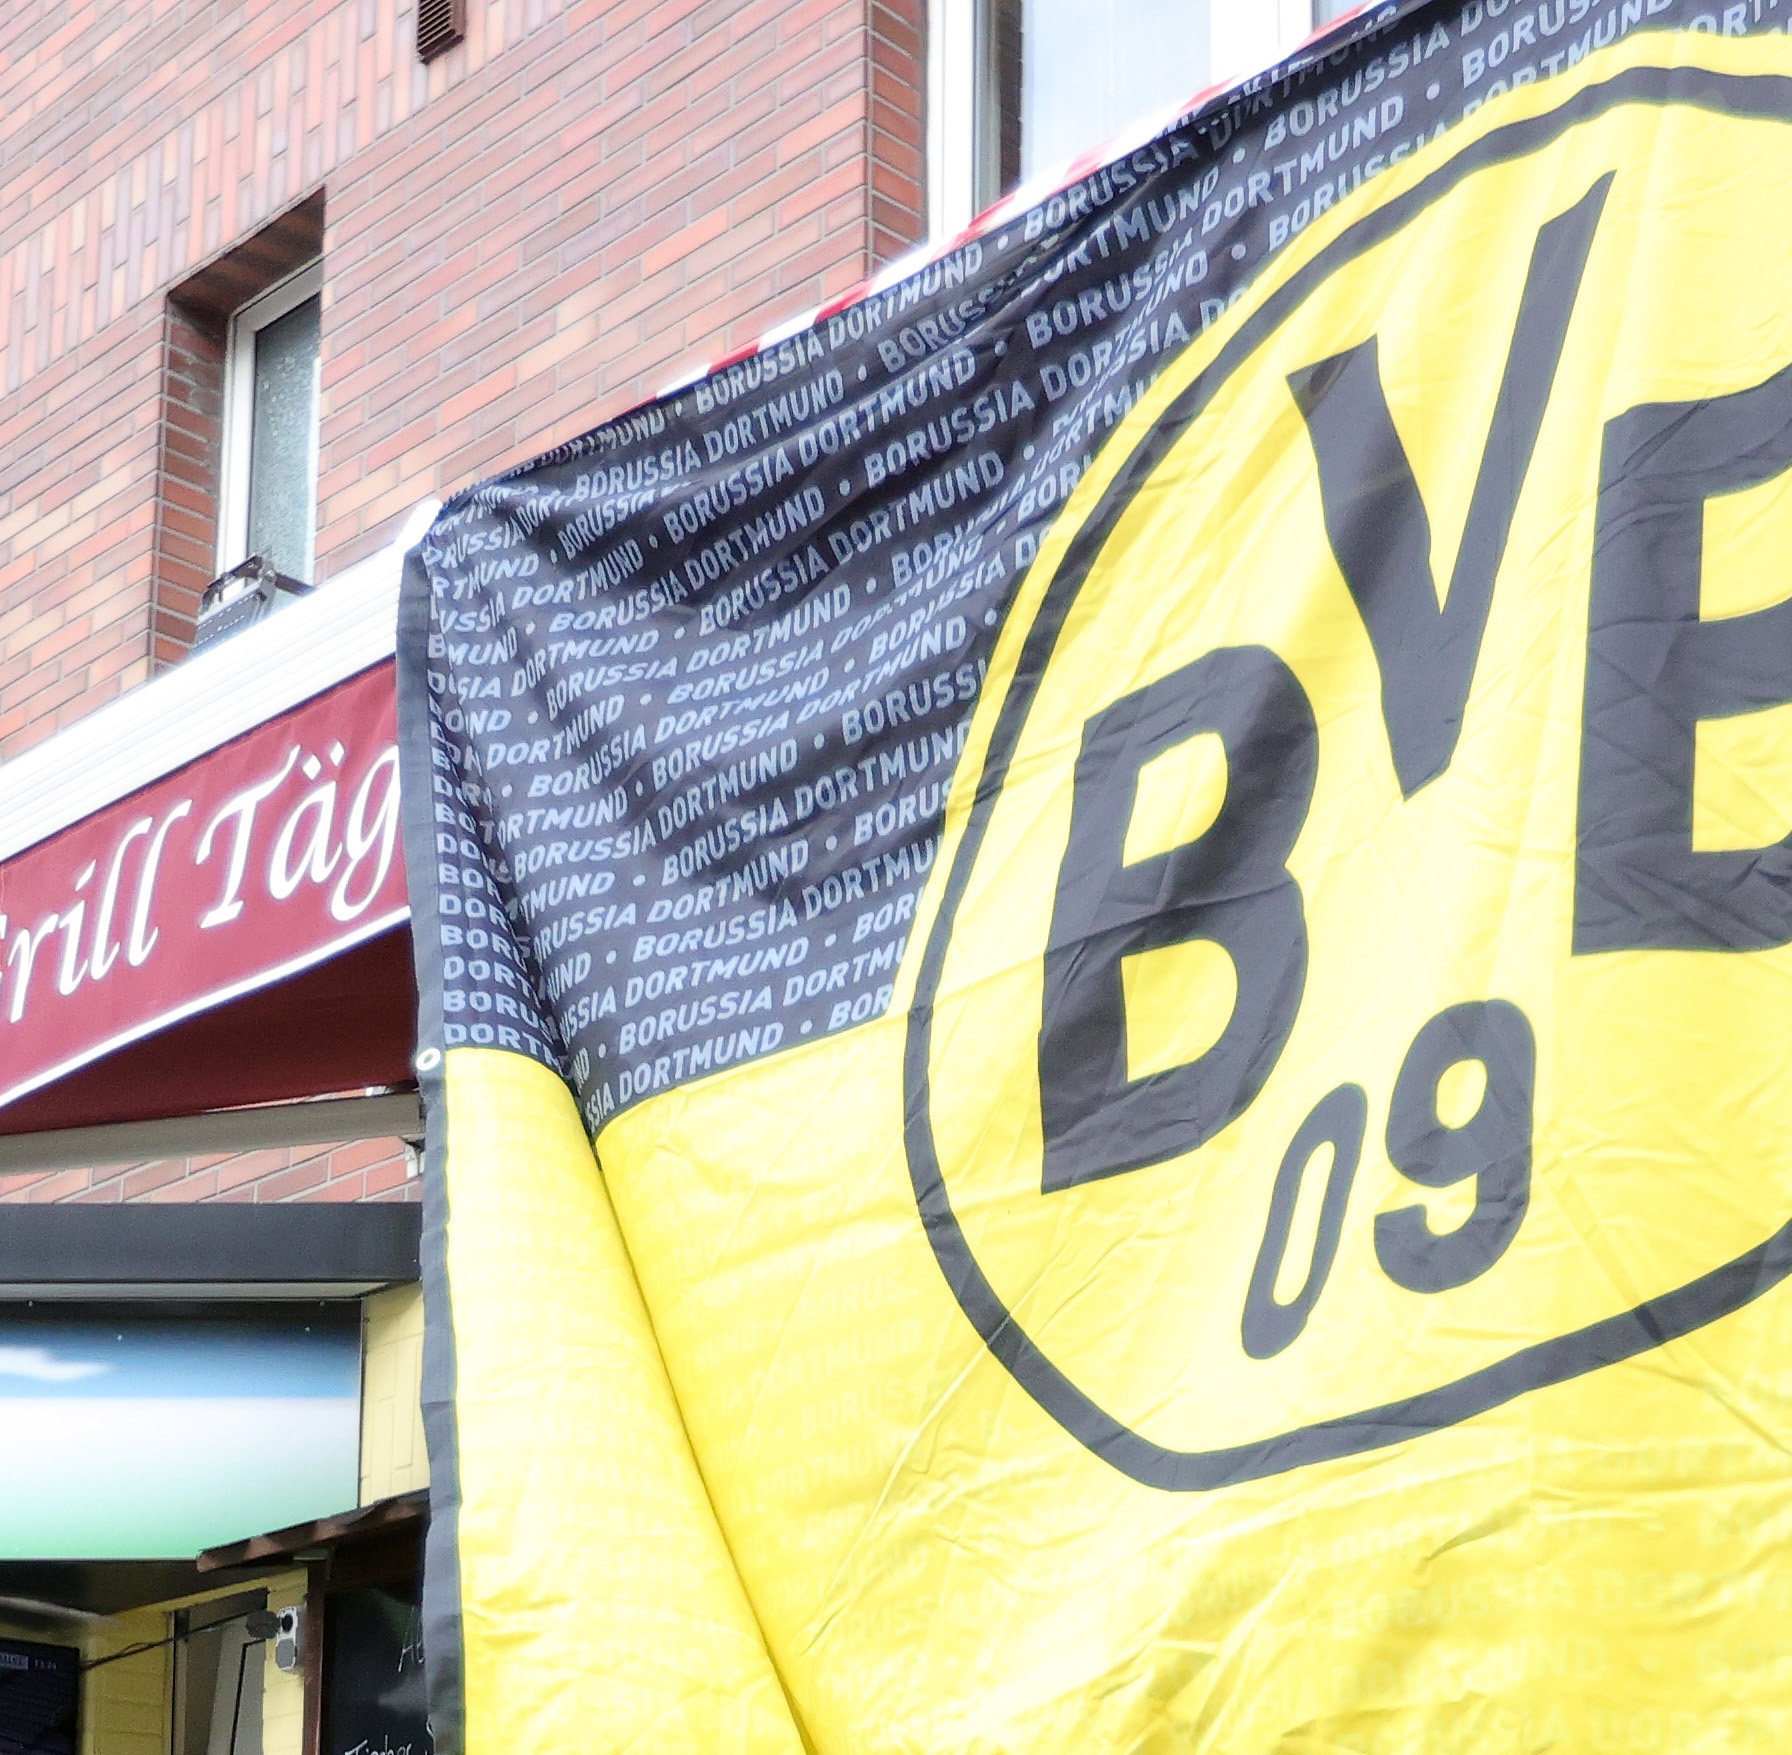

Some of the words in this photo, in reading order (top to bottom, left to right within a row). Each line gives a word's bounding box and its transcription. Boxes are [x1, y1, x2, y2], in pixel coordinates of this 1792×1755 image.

[574, 439, 703, 502] BORUSSIA
[704, 369, 844, 464] DORTMUND
[1264, 22, 1451, 151] BORUSSIA
[511, 538, 644, 610] DORTMUND
[663, 446, 795, 544] BORUSSIA
[798, 348, 978, 467] DORTMUND
[1201, 95, 1405, 237] DORTMUND
[695, 327, 824, 415] BORUSSIA
[829, 248, 984, 350] DORTMUND
[549, 570, 688, 633] BORUSSIA
[684, 486, 825, 590] DORTMUND
[864, 379, 1035, 488] BORUSSIA
[558, 489, 657, 561] BORUSSIA
[511, 629, 659, 697] DORTMUND
[699, 545, 830, 636] BORUSSIA
[828, 452, 1005, 565] DORTMUND
[486, 695, 625, 769] DORTMUND
[667, 639, 825, 704] BORUSSIA
[546, 656, 678, 721] BORUSSIA
[686, 583, 851, 673] DORTMUND
[652, 711, 790, 791] BORUSSIA
[796, 615, 966, 724] DORTMUND
[528, 724, 646, 797] BORUSSIA
[655, 667, 830, 744] DORTMUND
[514, 818, 656, 884] BORUSSIA
[660, 738, 798, 840] DORTMUND
[662, 797, 788, 886] BORUSSIA
[632, 898, 798, 963] BORUSSIA
[647, 839, 808, 922] DORTMUND
[619, 985, 772, 1054] BORUSSIA
[625, 937, 809, 1008] DORTMUND
[619, 1021, 784, 1103] DORTMUND
[1241, 999, 1537, 1359] 09
